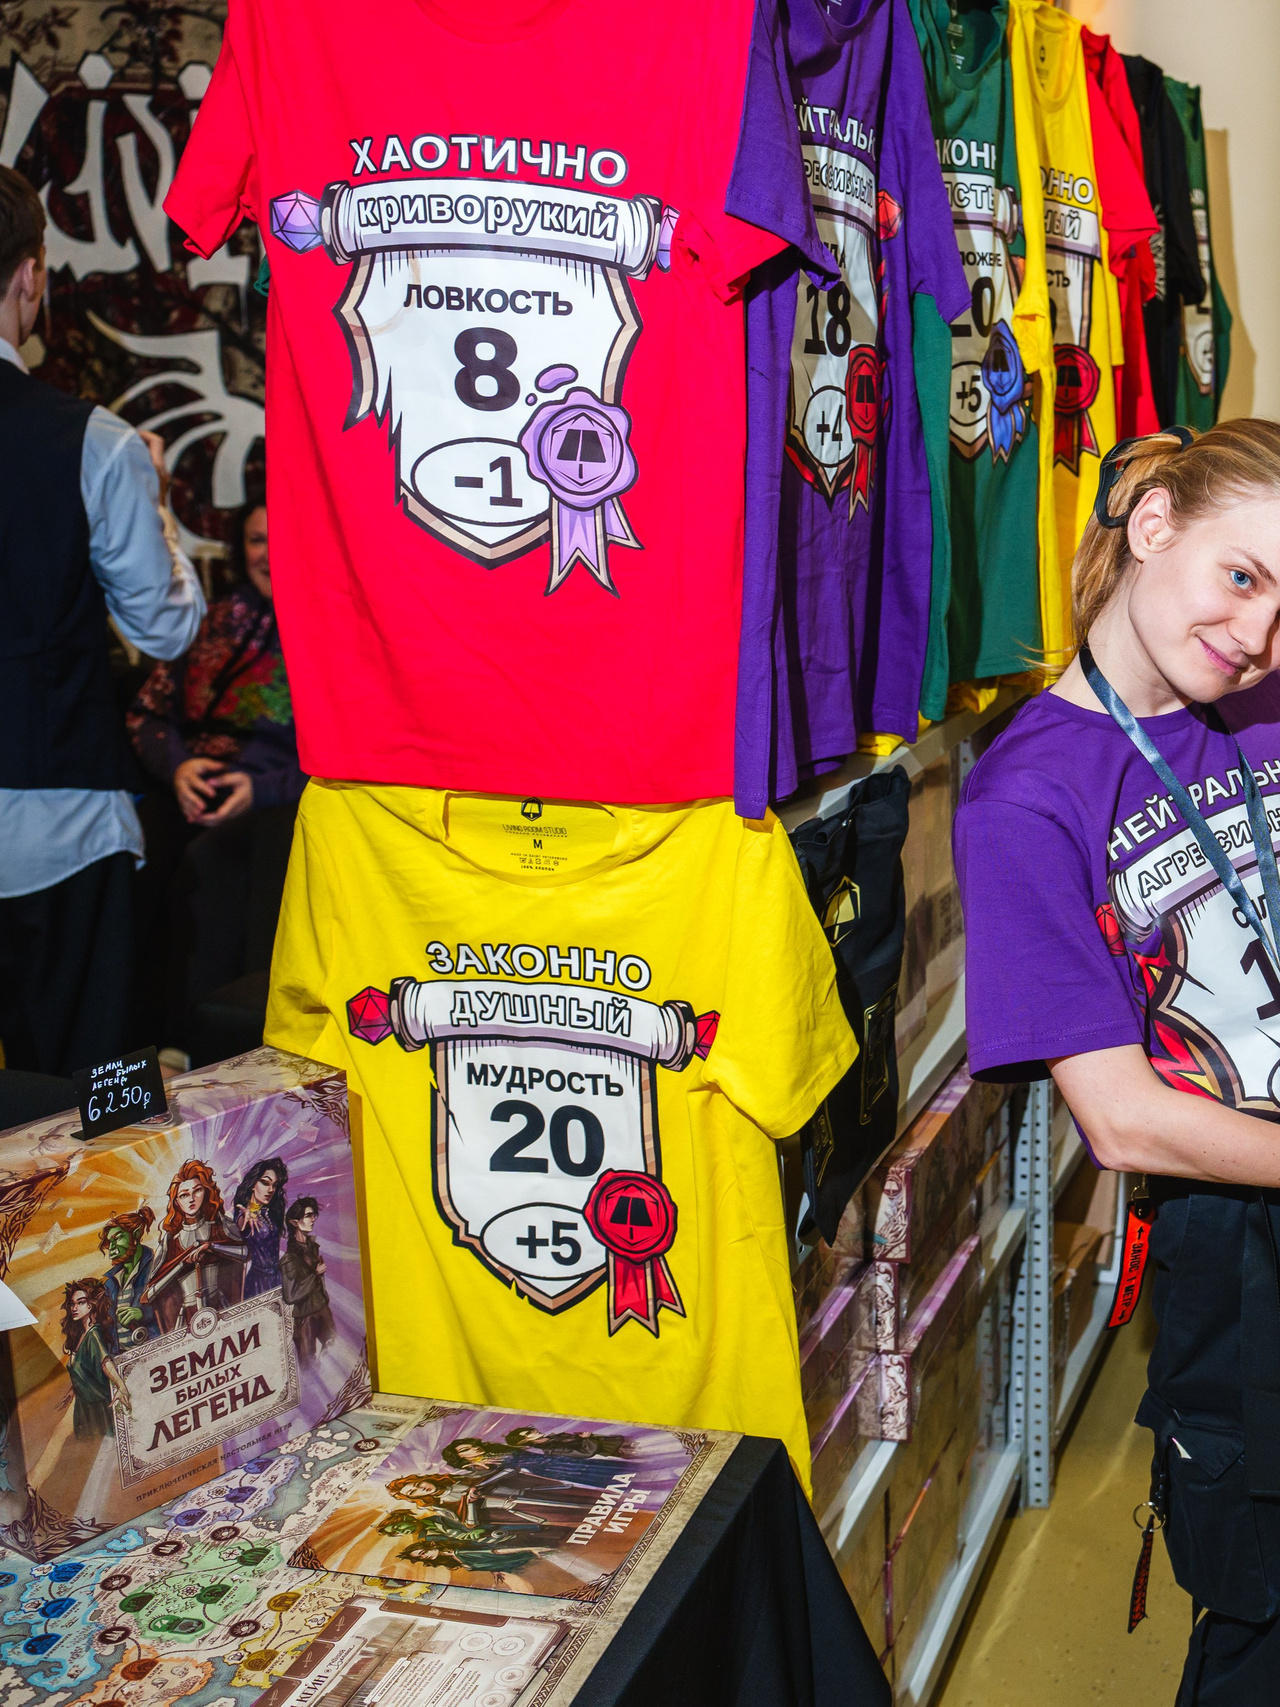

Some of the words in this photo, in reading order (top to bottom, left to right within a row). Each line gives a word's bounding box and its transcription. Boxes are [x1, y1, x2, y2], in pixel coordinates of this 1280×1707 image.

[350, 133, 629, 186] ХАОТИЧНО
[357, 194, 621, 241] криворукий
[403, 284, 573, 316] ЛОВКОСТЬ
[804, 281, 851, 357] 18
[454, 327, 521, 412] 8
[956, 375, 982, 412] +5
[816, 404, 844, 449] +4
[454, 456, 523, 507] -1
[502, 824, 522, 833] LIVING
[524, 826, 542, 834] ROOM
[545, 826, 567, 835] STUDIO
[533, 839, 543, 849] M
[425, 941, 652, 992] ЗАКОННО
[450, 991, 632, 1038] ДУШНЫЙ
[91, 1060, 123, 1079] ЗЕМЛИ
[116, 1060, 147, 1077] БЫЛЫХ
[467, 1061, 625, 1098] МУДРОСТЬ
[489, 1101, 606, 1178] 20
[515, 1221, 583, 1266] +5
[1128, 1242, 1144, 1273] ЗАНОС
[1121, 1284, 1135, 1307] МЕТР
[150, 1322, 262, 1394] ЗЕМЛИ
[176, 1363, 243, 1405] БЫЛЫХ
[146, 1374, 277, 1451] ЛЕГЕНД
[136, 1458, 218, 1502] ПРИКЛЮЧЕНЧЕСКАЯ
[220, 1433, 272, 1461] НАСТОЛЬНАЯ
[273, 1421, 293, 1436] ИГРА
[566, 1473, 636, 1545] ПРАВИЛА
[603, 1488, 651, 1533] ИГРЫ
[296, 1675, 329, 1703] КЕЙН
